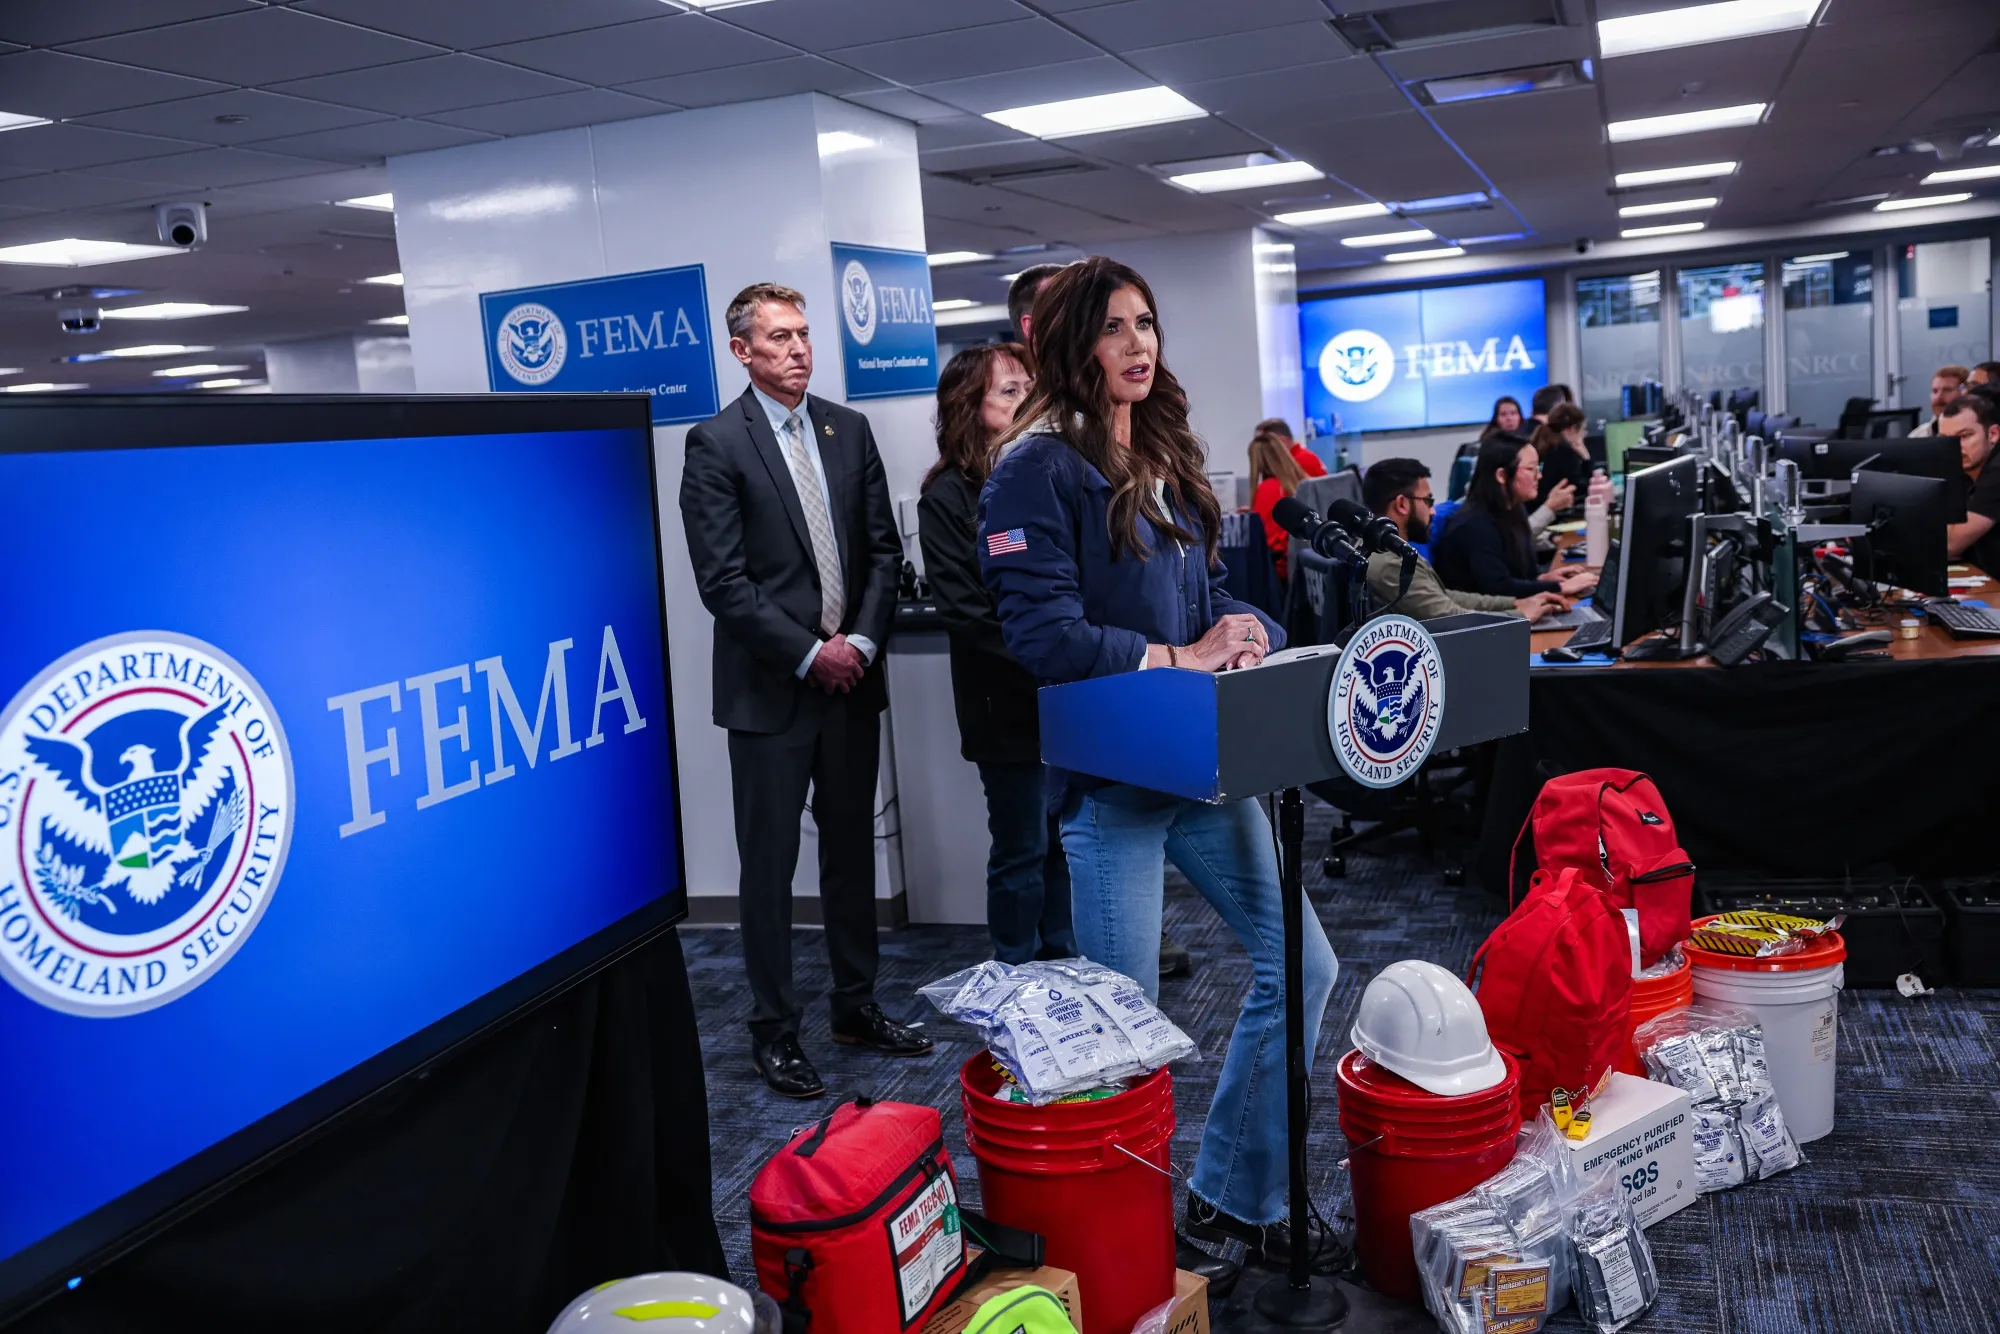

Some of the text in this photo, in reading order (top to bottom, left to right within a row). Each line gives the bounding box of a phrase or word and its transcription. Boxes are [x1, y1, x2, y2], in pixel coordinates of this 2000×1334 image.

[878, 286, 931, 323] FEMA
[576, 307, 700, 358] FEMA
[1404, 334, 1536, 379] FEMA
[659, 384, 687, 395] Center
[1338, 623, 1439, 698] U.S. DEPARTMENT OF
[28, 652, 252, 733] DEPARTMENT
[244, 718, 274, 761] OF
[327, 624, 646, 840] FEMA
[1338, 700, 1439, 780] HOMELAND SECURITY
[180, 801, 279, 972] SECURITY
[1045, 996, 1076, 1011] EMERGENCY
[1046, 1001, 1083, 1018] DRINKING
[1055, 1009, 1082, 1022] WATER
[1124, 1000, 1144, 1010] WATER
[1583, 1113, 1685, 1172] EMERGENCY PURIFIED
[1616, 1132, 1676, 1169] KING WATER
[1694, 1130, 1724, 1140] DRINKING
[1621, 1160, 1659, 1195] SOS
[1628, 1194, 1643, 1205] od
[1644, 1185, 1657, 1199] lab
[899, 1208, 920, 1238] FEMA
[919, 1192, 938, 1219] TECC
[1498, 1275, 1546, 1291] EMERGENCY BLANKET
